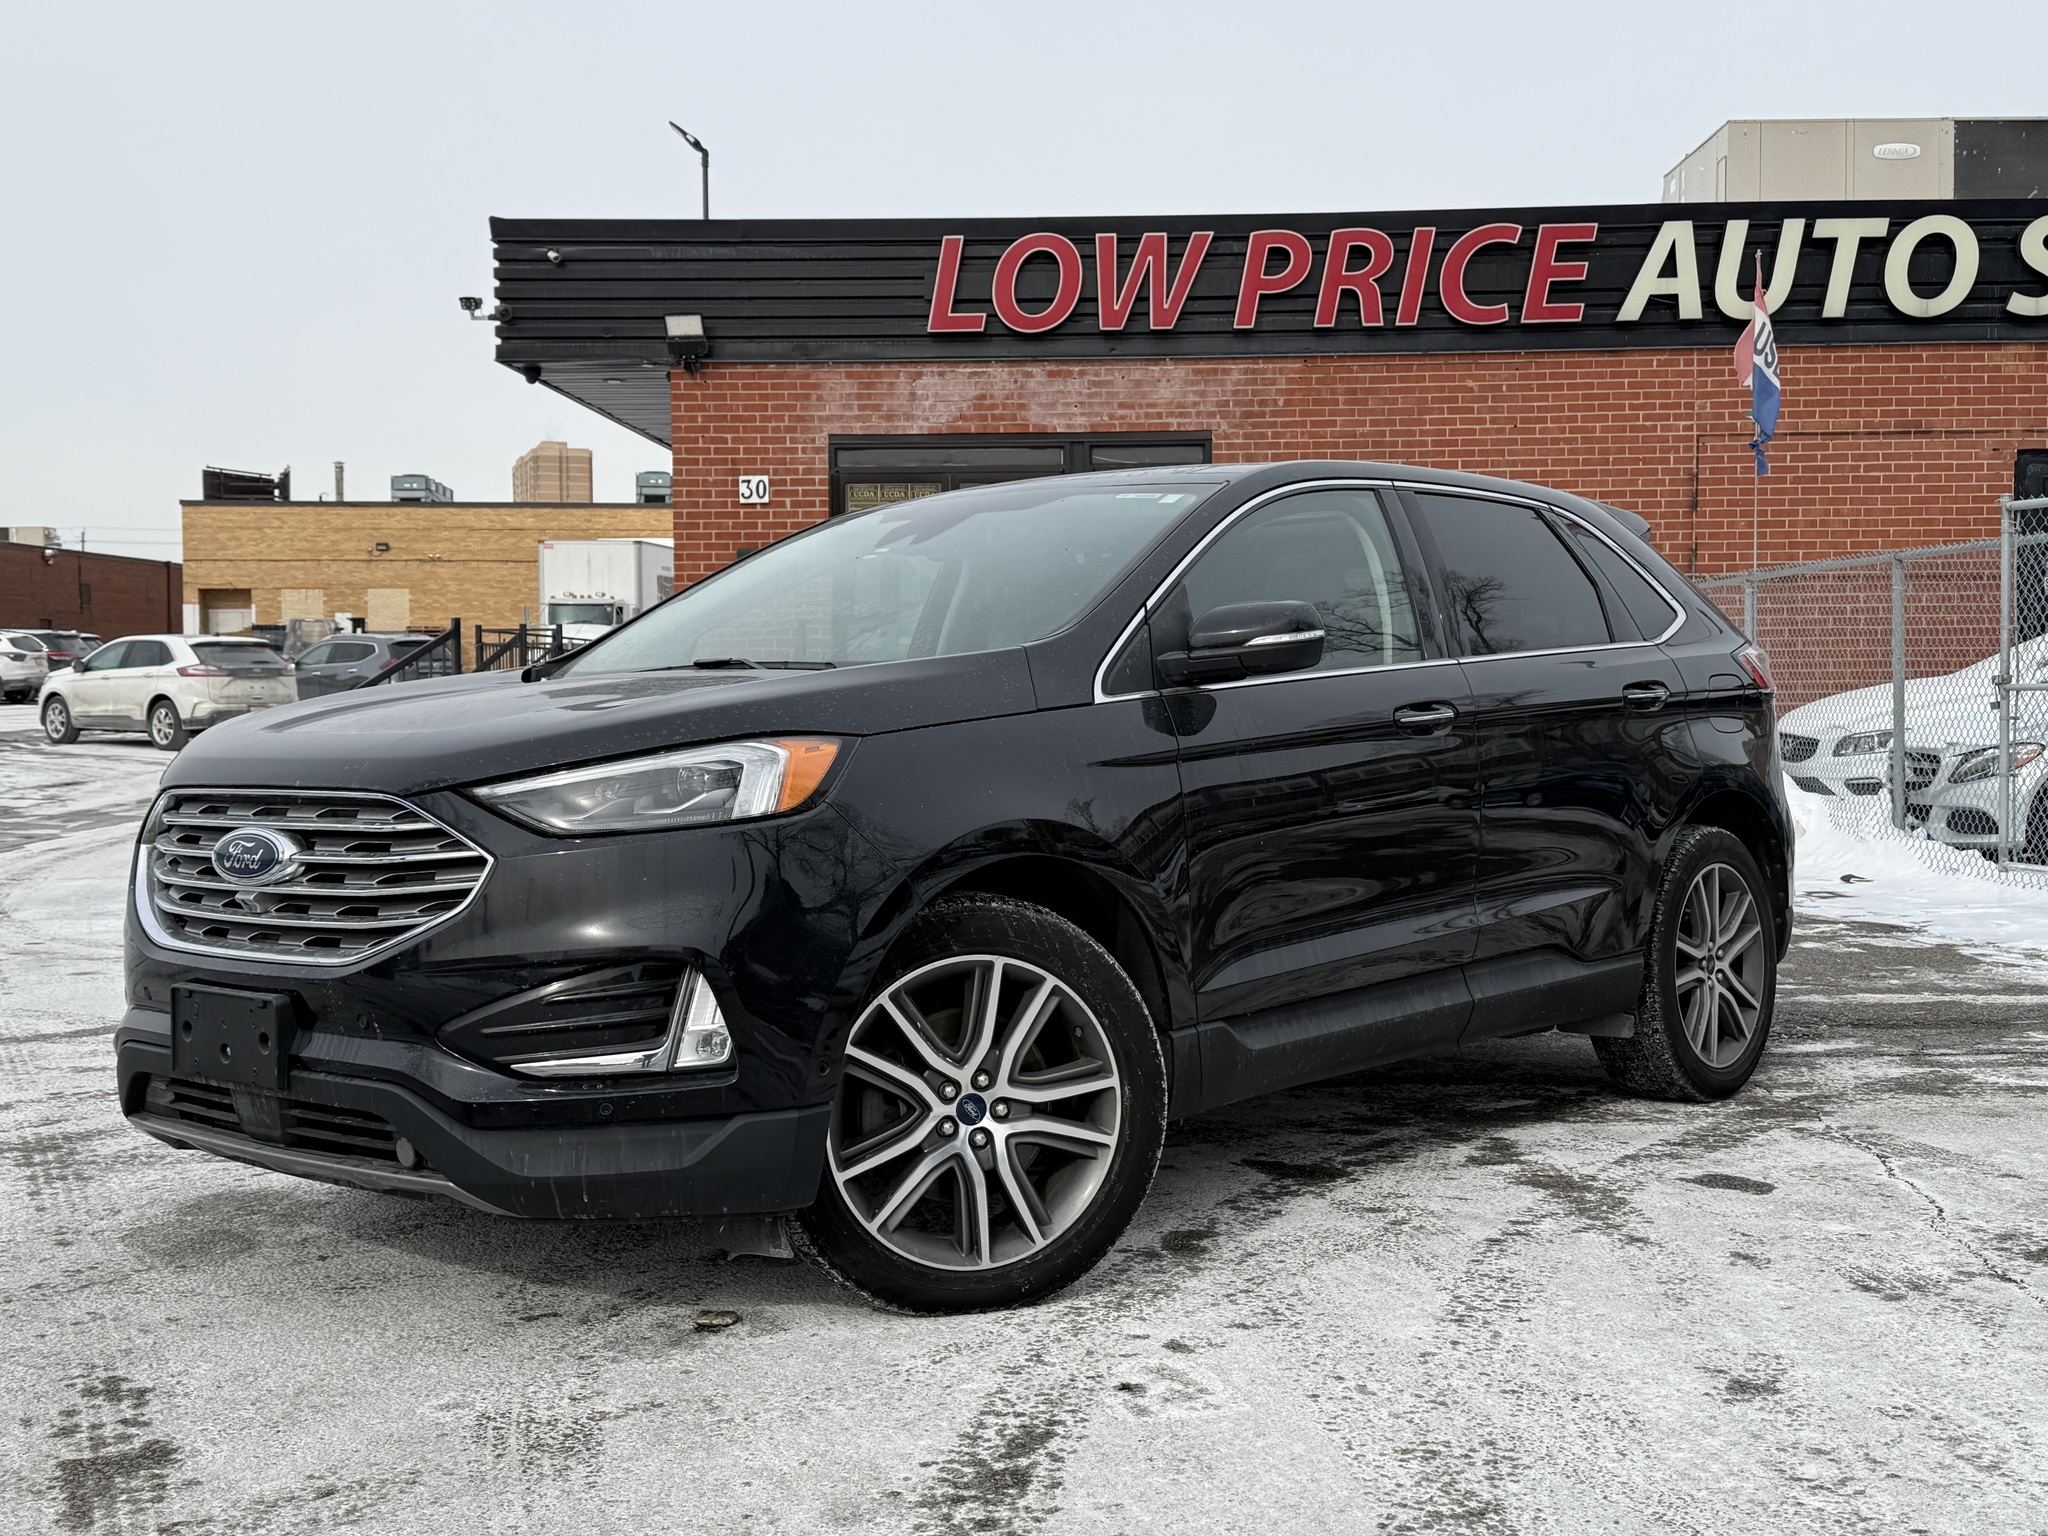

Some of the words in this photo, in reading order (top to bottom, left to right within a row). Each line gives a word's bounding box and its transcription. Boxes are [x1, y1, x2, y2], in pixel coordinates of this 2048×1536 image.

[927, 231, 1214, 334] LOW
[1233, 223, 1598, 328] PRICE
[1615, 214, 1980, 320] AUTO
[740, 479, 767, 500] 30
[223, 840, 264, 870] Ford
